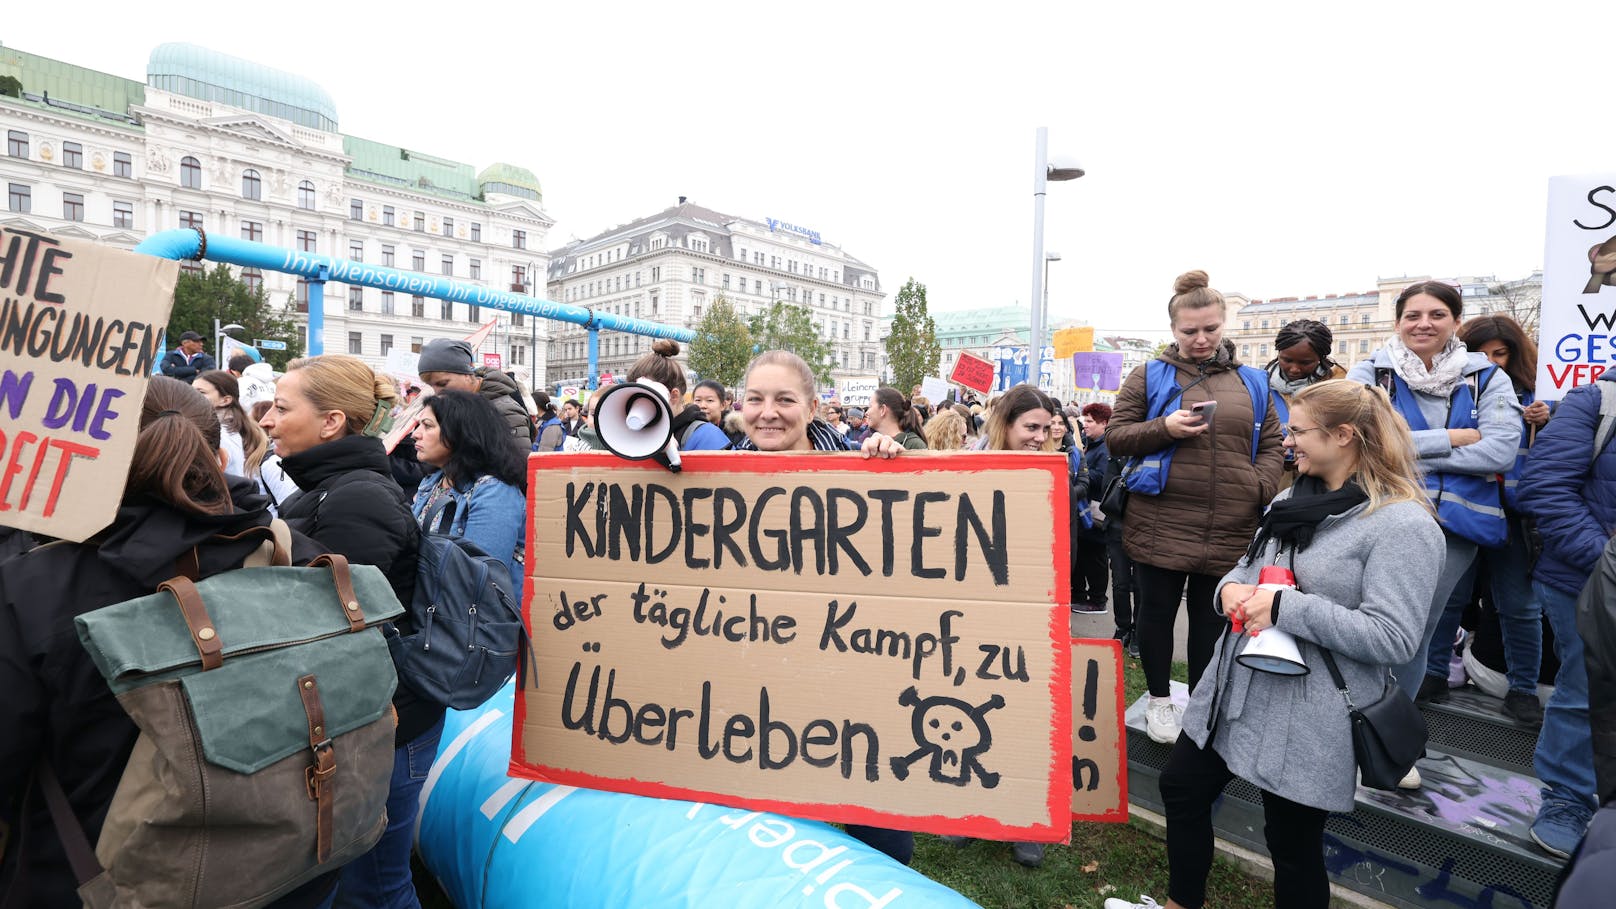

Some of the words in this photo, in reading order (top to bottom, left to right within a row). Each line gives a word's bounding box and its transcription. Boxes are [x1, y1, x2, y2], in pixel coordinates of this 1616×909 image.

[780, 220, 821, 241] VOLKSBANK
[283, 250, 320, 273] Ihr
[328, 257, 437, 294] Menschen!
[447, 283, 471, 300] Ihr
[41, 377, 126, 440] DIE
[565, 481, 1009, 586] KINDERGARTEN
[552, 593, 608, 631] der
[632, 582, 797, 649] tägliche
[819, 600, 967, 686] Kampf,
[977, 643, 1030, 682] zu
[561, 642, 880, 783] Überleben
